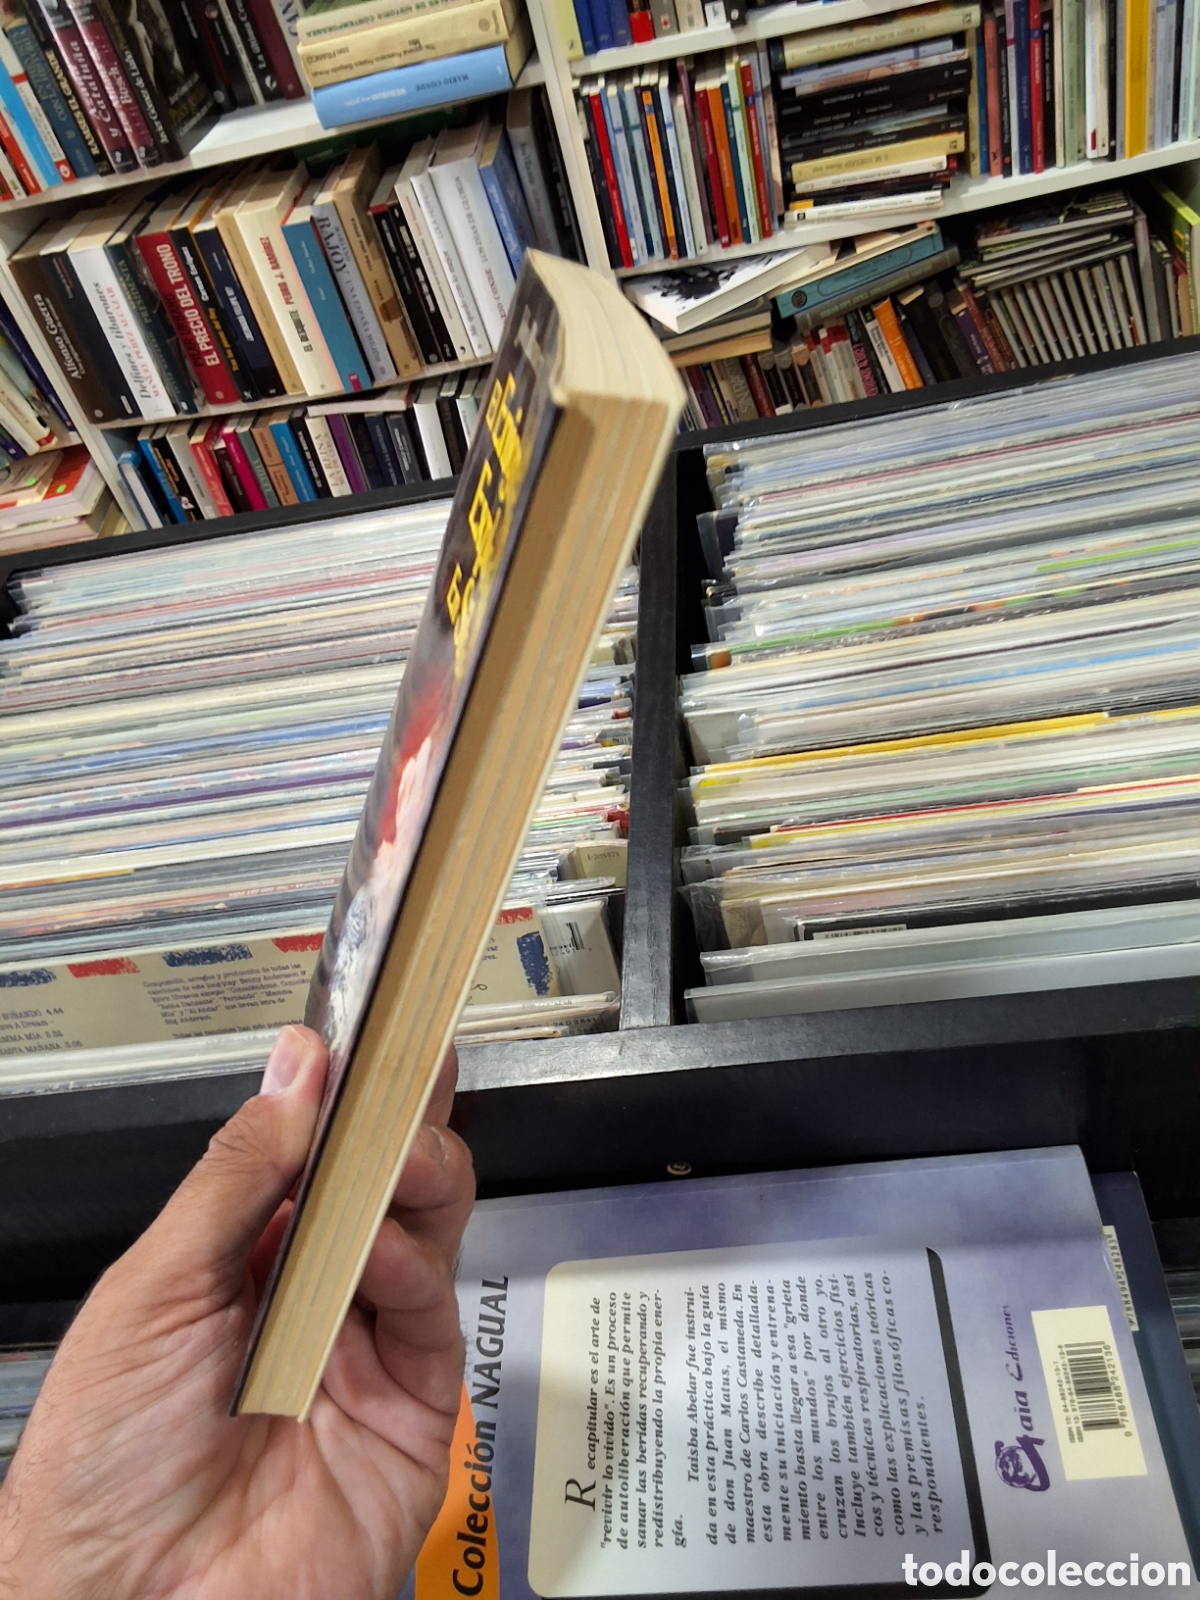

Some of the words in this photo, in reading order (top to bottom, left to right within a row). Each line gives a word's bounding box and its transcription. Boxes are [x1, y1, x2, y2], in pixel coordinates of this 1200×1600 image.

[241, 20, 261, 54] última
[305, 50, 335, 63] FRANCO
[45, 49, 72, 96] GRANDE
[254, 54, 267, 69] La
[443, 73, 469, 85] MARIO
[67, 39, 110, 125] Cataluña
[133, 74, 145, 89] de
[414, 79, 442, 91] CONDE
[66, 95, 79, 111] EL
[73, 109, 99, 155] RAMSES
[453, 174, 470, 210] GLORIA
[430, 218, 444, 239] LOLA
[465, 211, 474, 223] DE
[155, 242, 181, 284] TRONO
[315, 215, 347, 274] RAJOY
[477, 245, 488, 264] LOS
[273, 270, 285, 282] J.
[277, 279, 295, 306] PEDRO
[454, 283, 464, 298] con
[484, 268, 501, 302] CONDE
[30, 292, 59, 337] Guerra
[91, 281, 124, 341] tiburones
[163, 292, 187, 337] URBANO
[173, 285, 192, 309] DEL
[353, 299, 372, 333] ESPAÑA
[183, 307, 210, 352] PRECIO
[302, 343, 313, 353] EL
[467, 323, 477, 336] Me
[52, 334, 81, 381] Alfonso
[183, 336, 201, 368] PILAR
[202, 349, 217, 367] EL
[122, 350, 152, 401] Delfines
[312, 433, 335, 470] REINA
[327, 472, 340, 487] LA
[238, 975, 261, 985] Benny
[270, 963, 289, 972] todas
[260, 997, 275, 1005] letra
[22, 1018, 48, 1028] Dream
[25, 1040, 62, 1053] MAÑANA
[697, 1284, 715, 1319] guía
[793, 1275, 810, 1322] donde
[814, 1273, 829, 1296] yo.
[826, 1272, 846, 1307] físi-
[842, 1274, 858, 1298] así
[881, 1270, 893, 1294] co-
[607, 1291, 621, 1350] proceso
[654, 1289, 663, 1327] ener-
[681, 1286, 696, 1340] instrui-
[712, 1281, 728, 1330] mismo
[746, 1279, 763, 1359] detallada-
[763, 1279, 780, 1348] entrena-
[813, 1305, 829, 1339] otro
[860, 1271, 881, 1334] teóricas
[472, 1274, 509, 1410] NAGUAL
[586, 1317, 600, 1347] arte
[617, 1292, 635, 1353] permite
[634, 1302, 651, 1398] recuperando
[650, 1330, 667, 1384] propia
[683, 1343, 700, 1369] fue
[698, 1340, 716, 1376] bajo
[730, 1304, 748, 1388] Castaneda.
[786, 1333, 797, 1360] esa
[802, 1331, 817, 1360] por
[830, 1309, 855, 1389] ejercicios
[845, 1300, 874, 1413] respiratorias,
[881, 1297, 910, 1393] filosóficas
[1104, 1343, 1120, 1382] 242136
[621, 1357, 634, 1386] que
[716, 1363, 735, 1417] Matus,
[683, 1371, 698, 1423] Abelar
[750, 1368, 767, 1439] describe
[768, 1363, 786, 1454] iniciación
[785, 1376, 806, 1424] llegar
[820, 1373, 842, 1428] brujos
[868, 1337, 899, 1453] explicaciones
[583, 1387, 602, 1470] ecapitular
[700, 1379, 719, 1451] práctica
[735, 1392, 751, 1444] Carlos
[838, 1394, 858, 1463] también
[1123, 1430, 1134, 1438] 9
[616, 1390, 630, 1523] autoliberación
[718, 1427, 733, 1466] Juan
[826, 1439, 841, 1463] los
[858, 1417, 878, 1487] técnicas
[893, 1396, 921, 1486] premisas
[633, 1469, 647, 1493] las
[650, 1407, 667, 1547] redistribuyendo
[702, 1455, 716, 1492] esta
[755, 1450, 770, 1492] obra
[808, 1455, 824, 1481] los
[882, 1456, 899, 1483] las
[912, 1395, 947, 1533] respondientes.
[453, 1421, 498, 1597] Colección
[720, 1478, 735, 1511] don
[739, 1472, 756, 1543] maestro
[775, 1484, 792, 1541] mente
[793, 1479, 811, 1540] miento
[833, 1474, 848, 1539] cruzan
[846, 1469, 869, 1537] Incluye
[890, 1486, 905, 1536] como
[905, 1490, 922, 1519] las
[637, 1497, 647, 1548] sanar
[670, 1513, 687, 1547] gía.
[758, 1504, 773, 1542] esta
[811, 1492, 829, 1539] entre
[871, 1506, 884, 1536] cos
